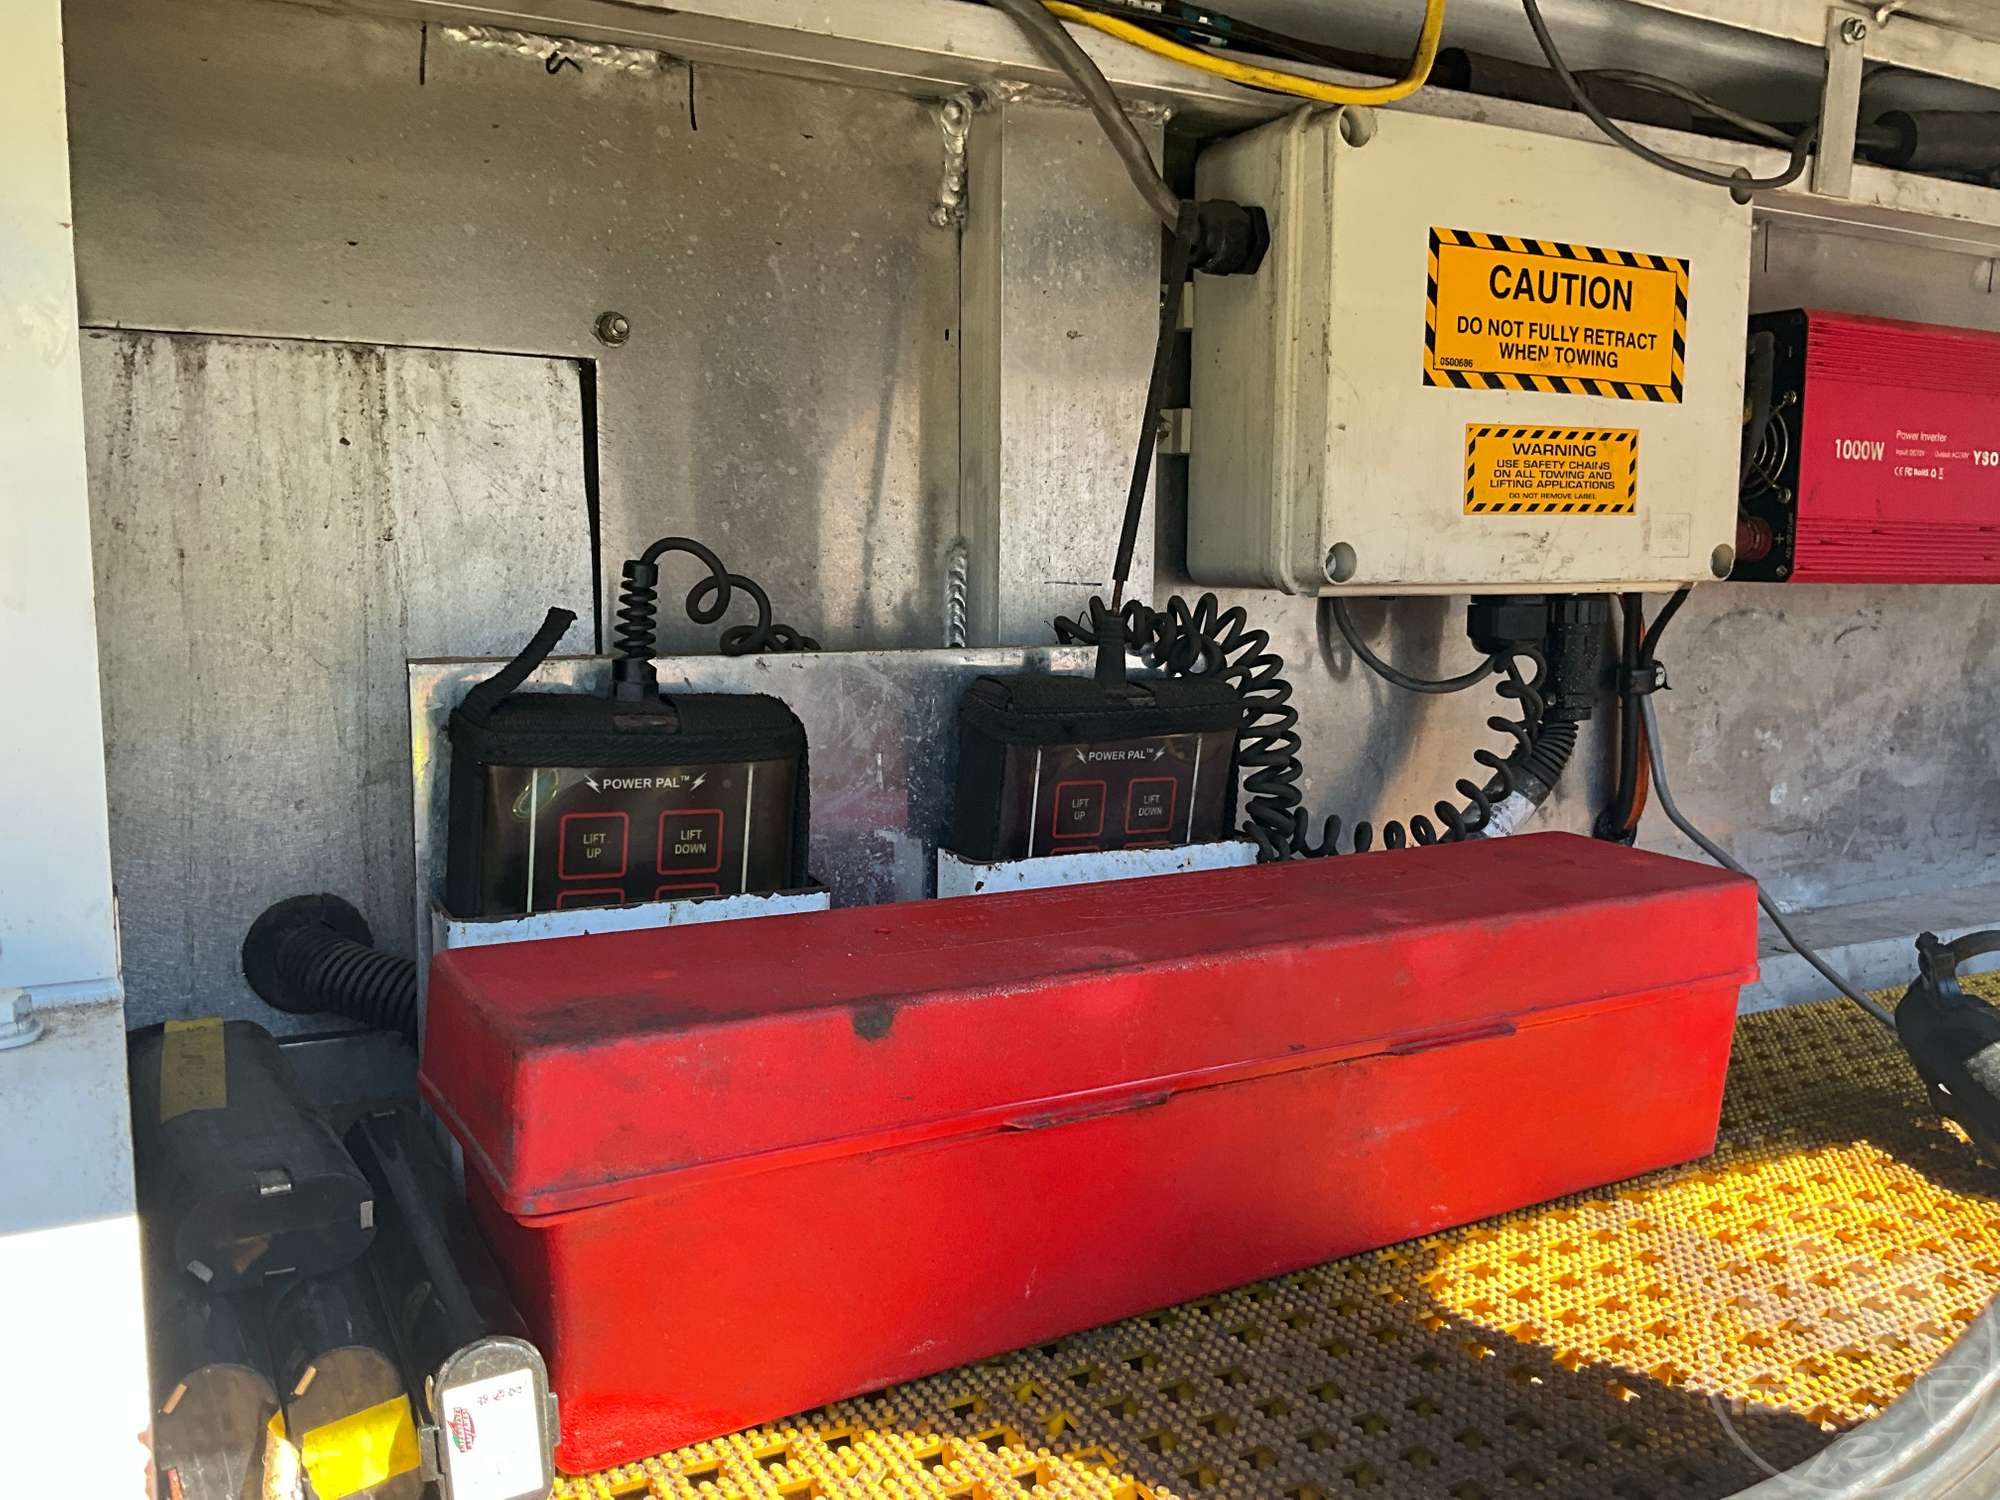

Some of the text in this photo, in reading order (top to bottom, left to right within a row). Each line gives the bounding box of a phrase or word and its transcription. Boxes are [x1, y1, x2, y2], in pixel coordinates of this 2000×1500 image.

[1489, 264, 1633, 312] CAUTION
[1457, 316, 1657, 351] DO NOT FULLY RETRACT
[1499, 342, 1618, 369] WHEN TOWING
[1896, 429, 1948, 443] Power Inverter
[1512, 443, 1597, 457] WARNING
[1834, 438, 1885, 462] 1000W
[1496, 459, 1610, 470] USE SAFETY CHAINS
[1493, 469, 1612, 480] ON ALL TOWING AND
[1490, 479, 1616, 490] LIFTING APPLICATIONS
[1540, 492, 1572, 500] REMOVE
[1088, 750, 1125, 761] POWER
[602, 777, 652, 790] POWER
[1072, 799, 1089, 809] LIFT
[1143, 795, 1160, 805] LIFT
[1073, 811, 1086, 820] UP
[1138, 807, 1162, 817] DOWN
[583, 833, 606, 845] LIFT
[680, 829, 702, 841] LIFT
[586, 848, 602, 859] UP
[674, 843, 707, 855] DOWN
